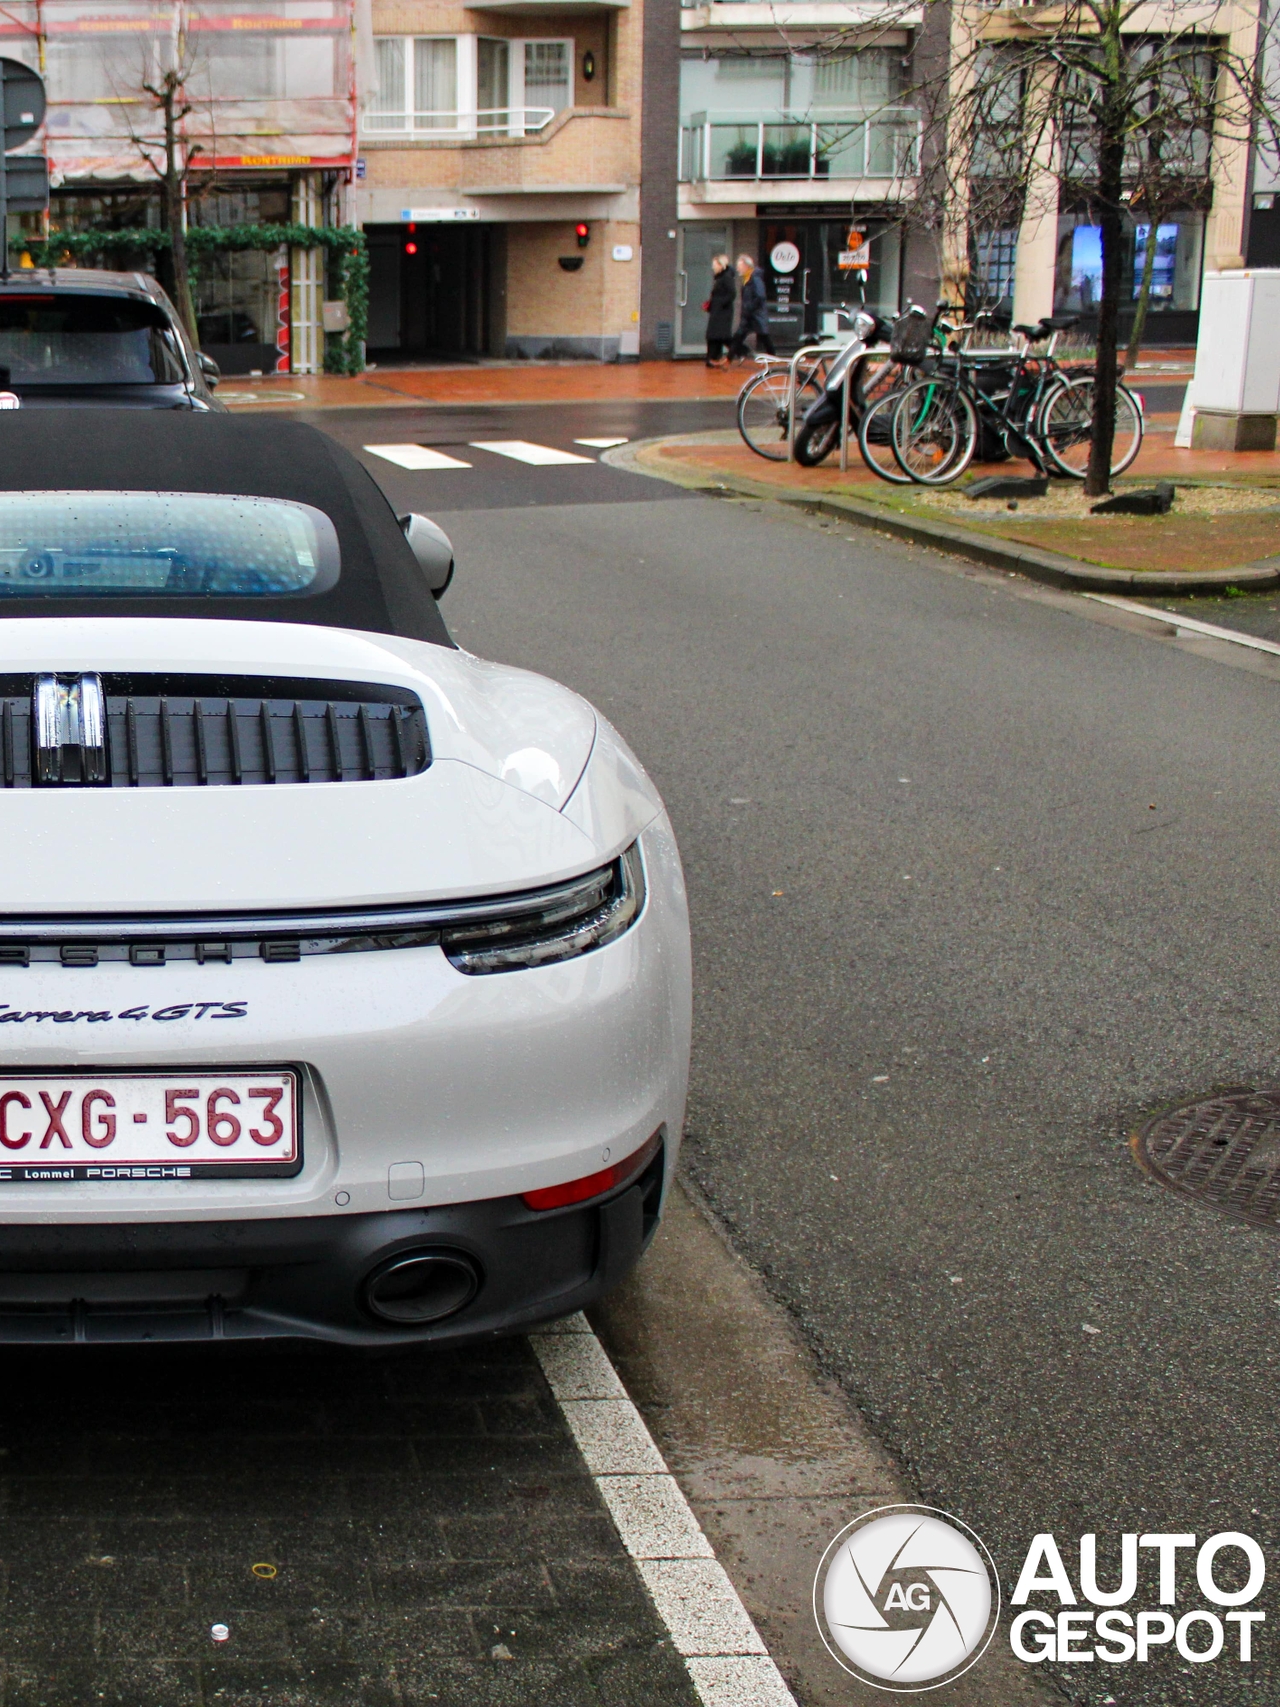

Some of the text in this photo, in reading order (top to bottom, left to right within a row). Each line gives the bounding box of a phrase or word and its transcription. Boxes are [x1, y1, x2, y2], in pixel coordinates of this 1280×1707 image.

[117, 1004, 151, 1021] 4
[151, 1001, 249, 1021] GTS
[24, 1168, 75, 1180] Lommel
[86, 1166, 192, 1179] PORSCHE
